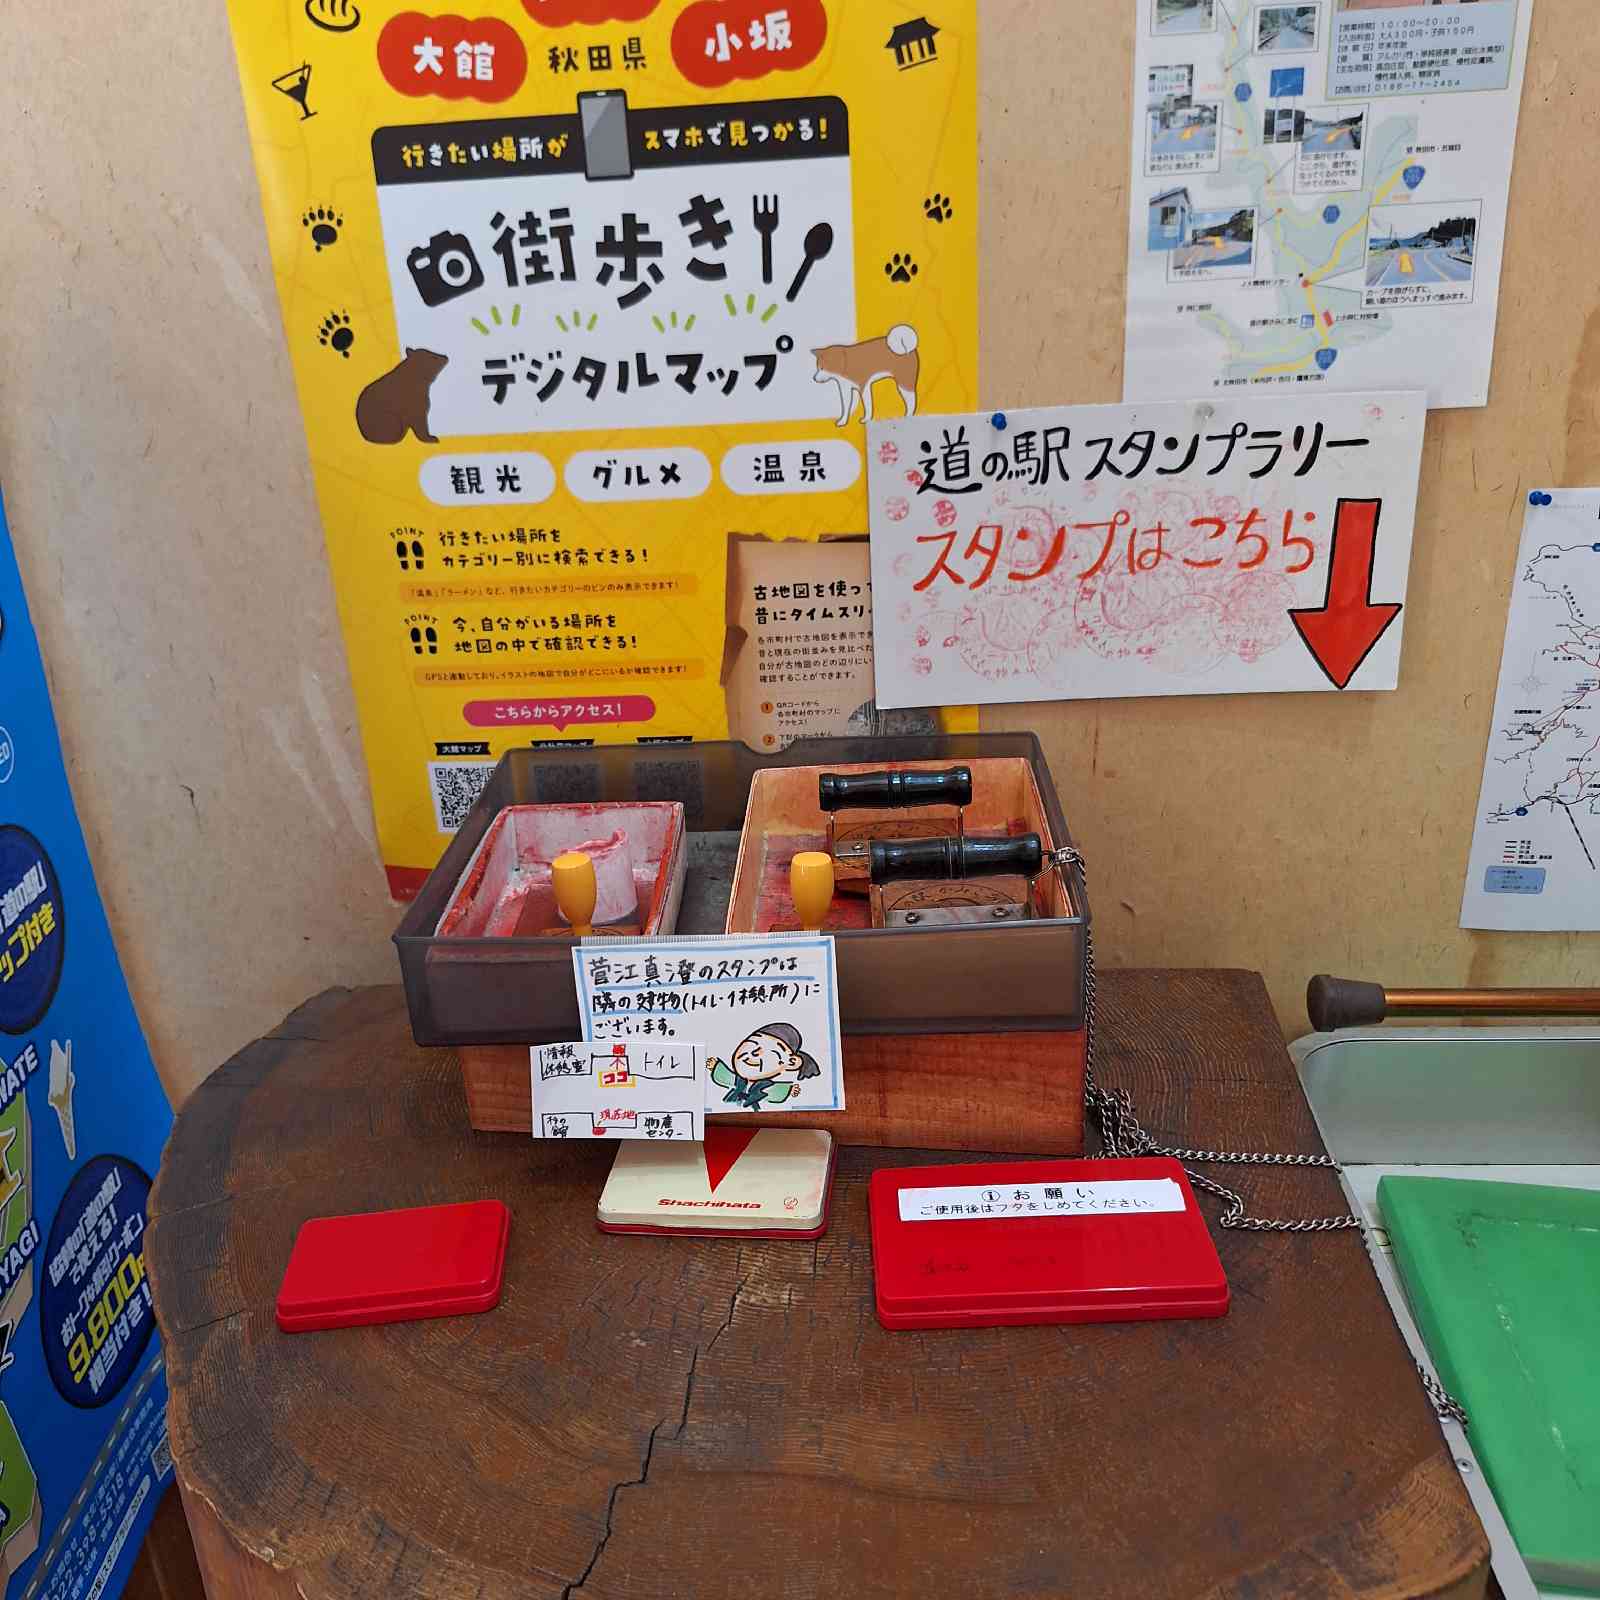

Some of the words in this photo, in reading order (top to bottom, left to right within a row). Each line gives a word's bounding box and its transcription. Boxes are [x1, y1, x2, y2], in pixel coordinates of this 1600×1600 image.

[704, 9, 793, 62] 小坂
[412, 37, 495, 80] 大館
[548, 37, 647, 73] 秋田県
[644, 118, 829, 150] スマホで見つかる！
[402, 133, 569, 168] 行きたい場所が
[490, 194, 734, 310] 街歩き
[481, 334, 794, 405] デジタルマップ
[592, 458, 682, 490] グルメ
[753, 450, 827, 484] 温泉
[449, 464, 523, 495] 観光
[439, 528, 561, 547] 行きたい場所を
[442, 549, 649, 567] カテゴリー別に検索できる！
[912, 508, 1317, 592] スタンプはこちら
[452, 613, 617, 633] 今、自分がいる場所を
[755, 604, 872, 625] 昔にタイムスリ
[455, 634, 638, 655] 地図の中で確認できる！
[495, 704, 623, 719] こちらからアクセス！
[593, 1017, 676, 1039] ございます。
[643, 1052, 679, 1071] トイレ
[602, 1070, 629, 1085] ココ
[657, 1198, 763, 1209] Shachihata
[1013, 1187, 1095, 1201] お願い
[920, 1198, 1156, 1216] ご使用後はフタをしめてください。
